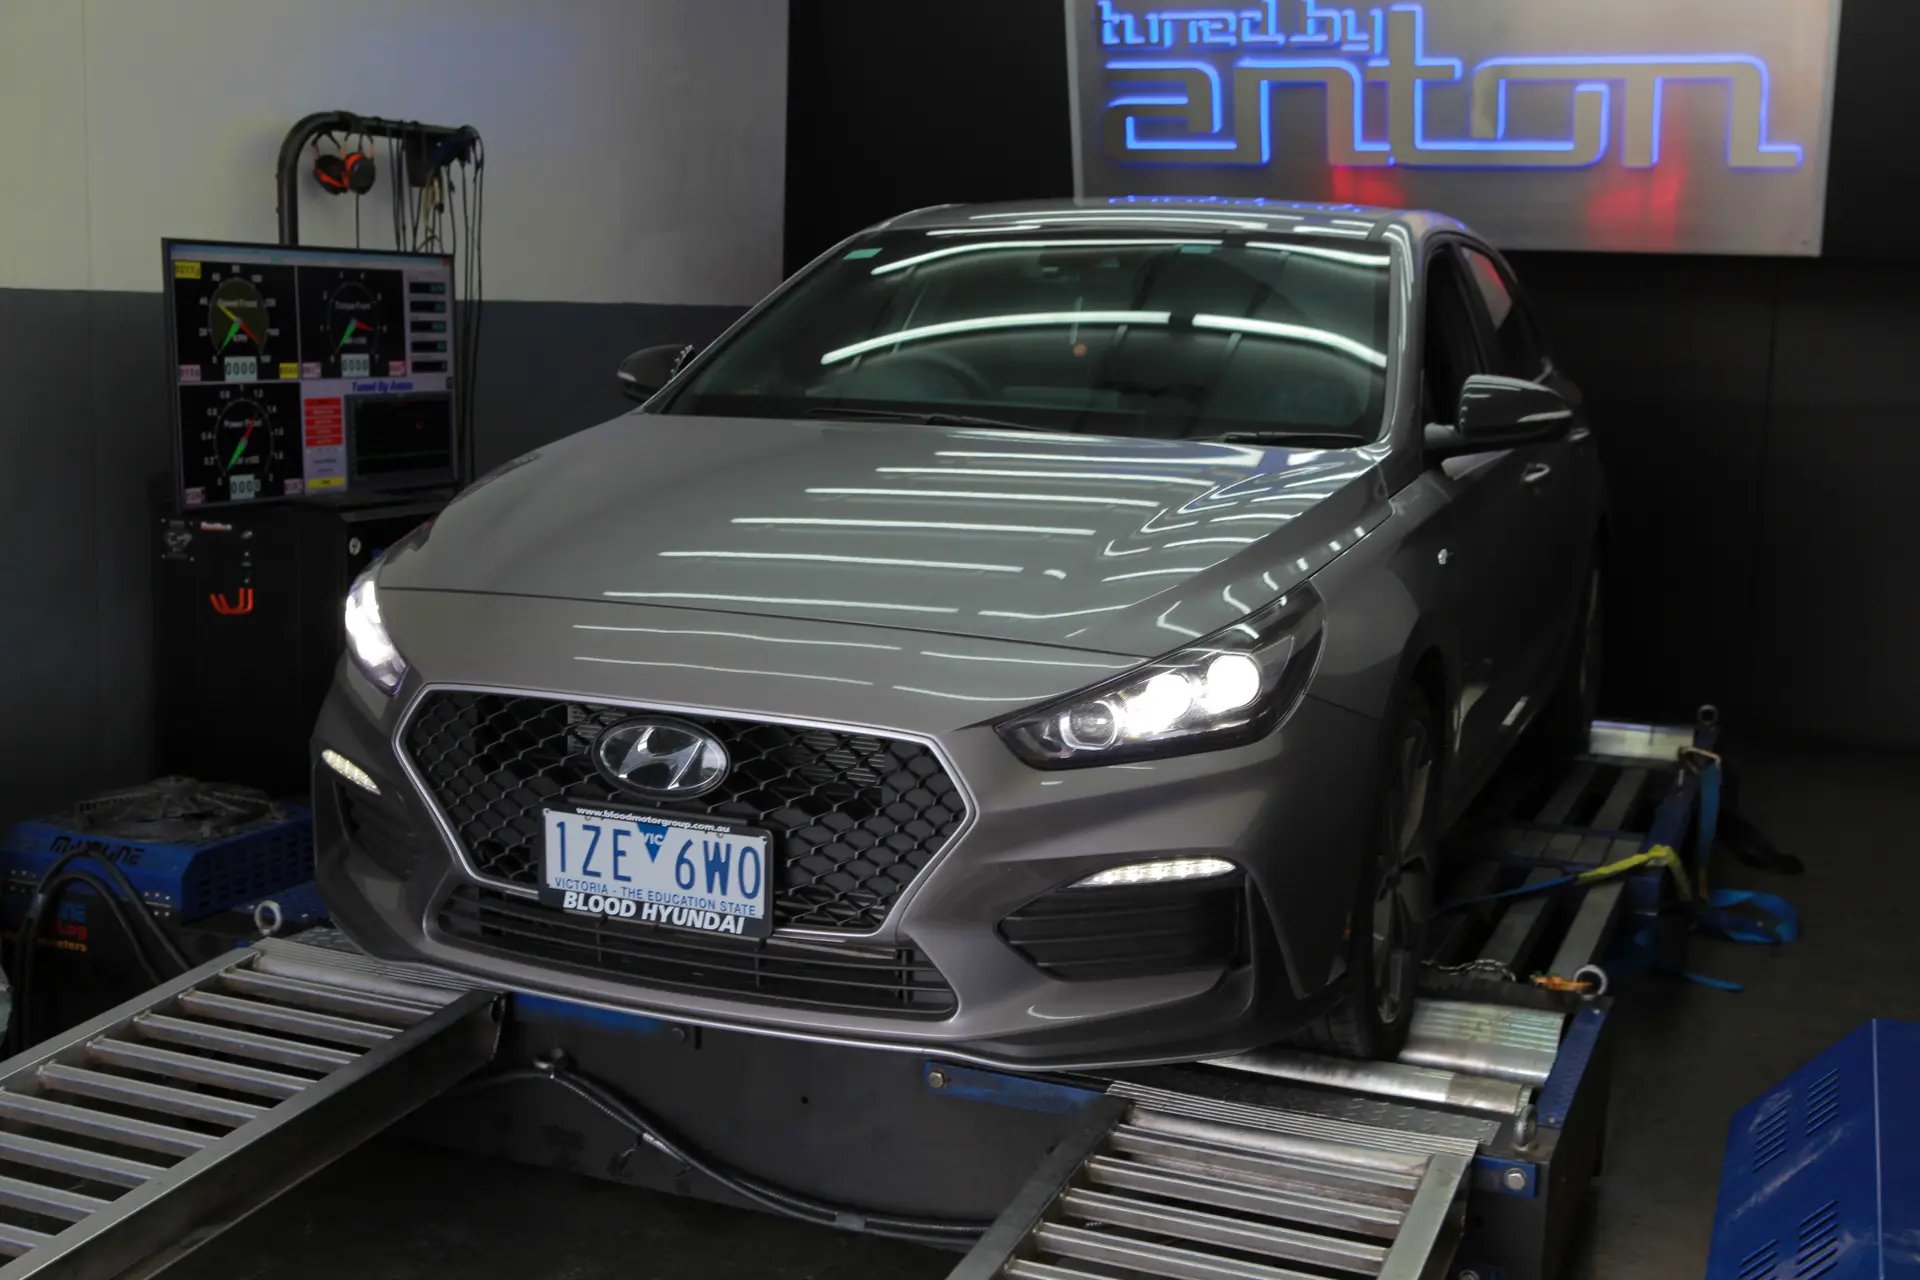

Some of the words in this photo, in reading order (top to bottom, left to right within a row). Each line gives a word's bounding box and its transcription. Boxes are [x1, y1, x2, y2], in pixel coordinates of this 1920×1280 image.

[1097, 0, 1286, 47] tuned
[1288, 0, 1384, 56] by
[1102, 3, 1804, 168] anton
[576, 807, 731, 833] www.bloodmotorgroup.com.au
[556, 821, 632, 882] 1ZE
[555, 877, 609, 895] VICTORIA
[621, 886, 643, 901] THE
[647, 890, 716, 911] EDUCATION
[719, 900, 756, 917] STATE
[563, 890, 637, 917] BLOOD
[641, 902, 746, 935] HYUNDAI
